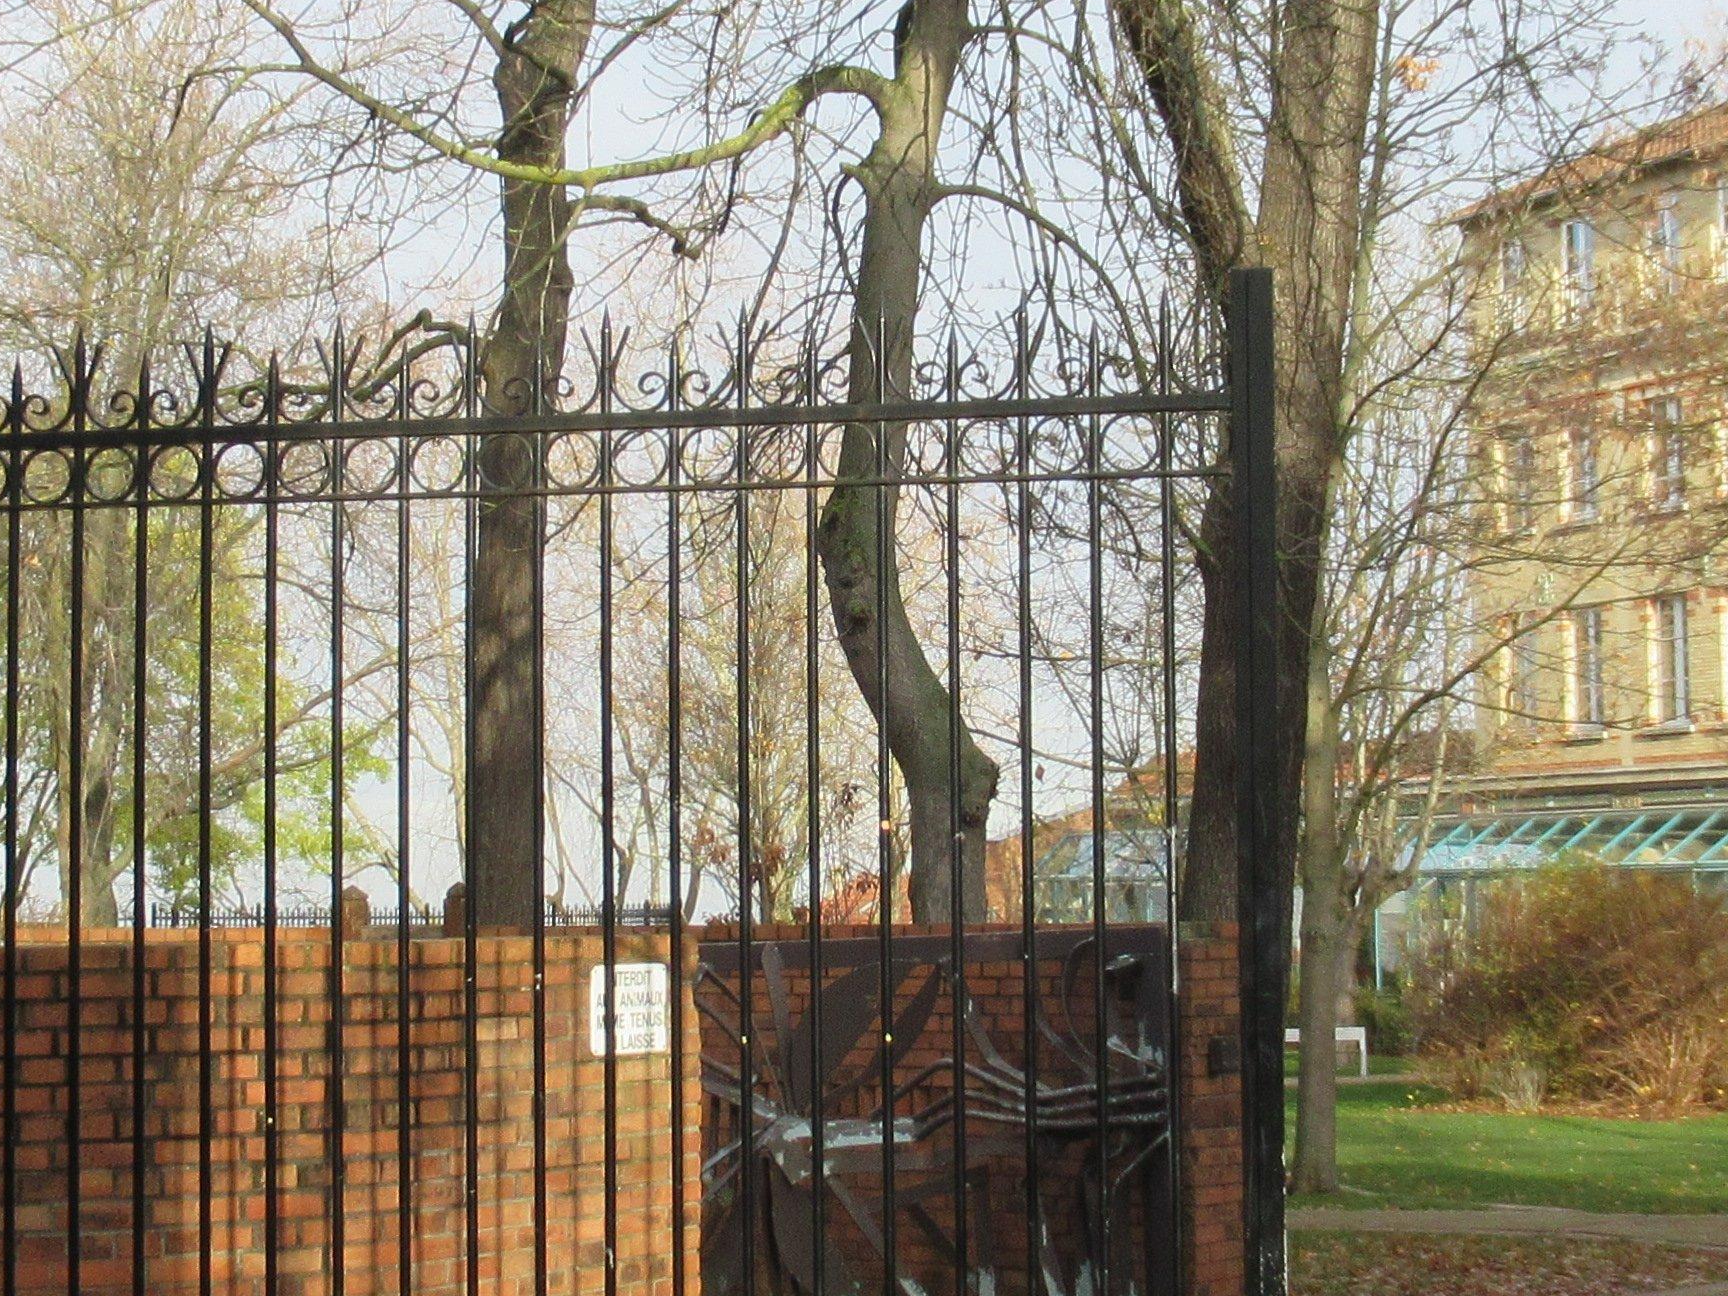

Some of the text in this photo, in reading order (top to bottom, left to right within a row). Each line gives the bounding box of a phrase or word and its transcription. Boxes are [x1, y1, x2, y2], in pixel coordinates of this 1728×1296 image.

[613, 970, 653, 988] TERDIT
[619, 990, 664, 1008] ANIMAUX
[629, 1011, 663, 1029] TENUS
[620, 1033, 656, 1050] LAISSE
